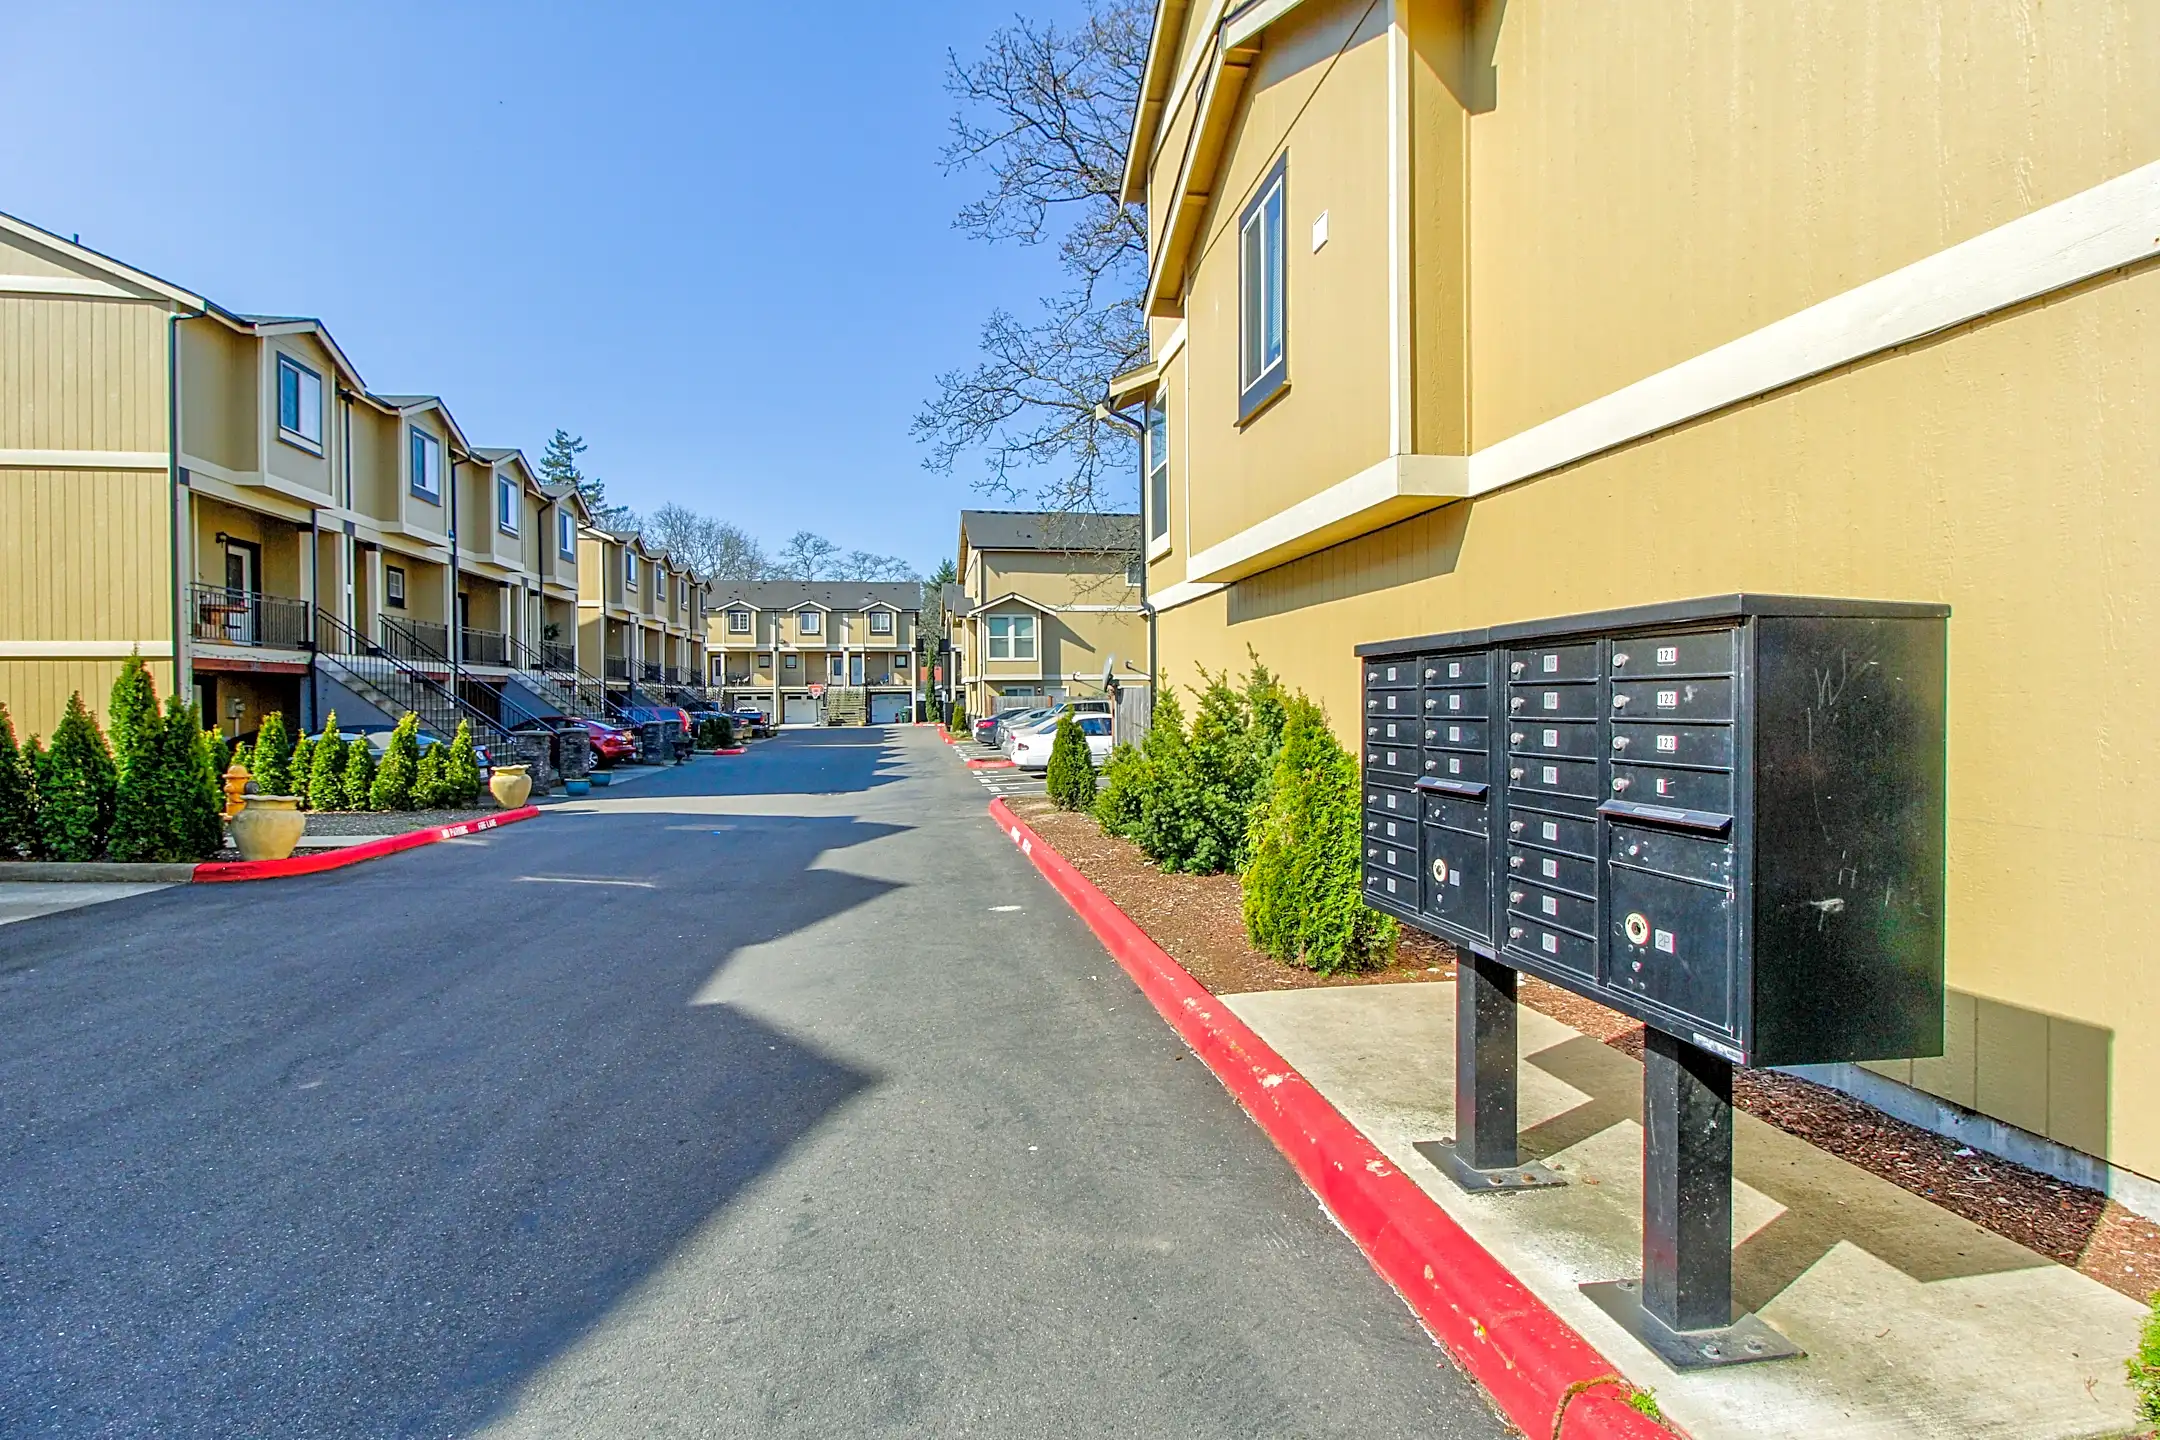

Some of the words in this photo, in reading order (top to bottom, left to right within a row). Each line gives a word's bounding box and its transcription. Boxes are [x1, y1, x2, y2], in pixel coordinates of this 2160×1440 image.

[1660, 650, 1674, 660] 121
[1545, 657, 1555, 670] 113
[1546, 694, 1555, 706] 114
[1660, 694, 1673, 704] 122
[1545, 732, 1555, 744] 115
[1660, 738, 1674, 748] 123
[1545, 769, 1554, 781] 116
[1545, 824, 1554, 837] 117
[1658, 933, 1670, 947] 2P
